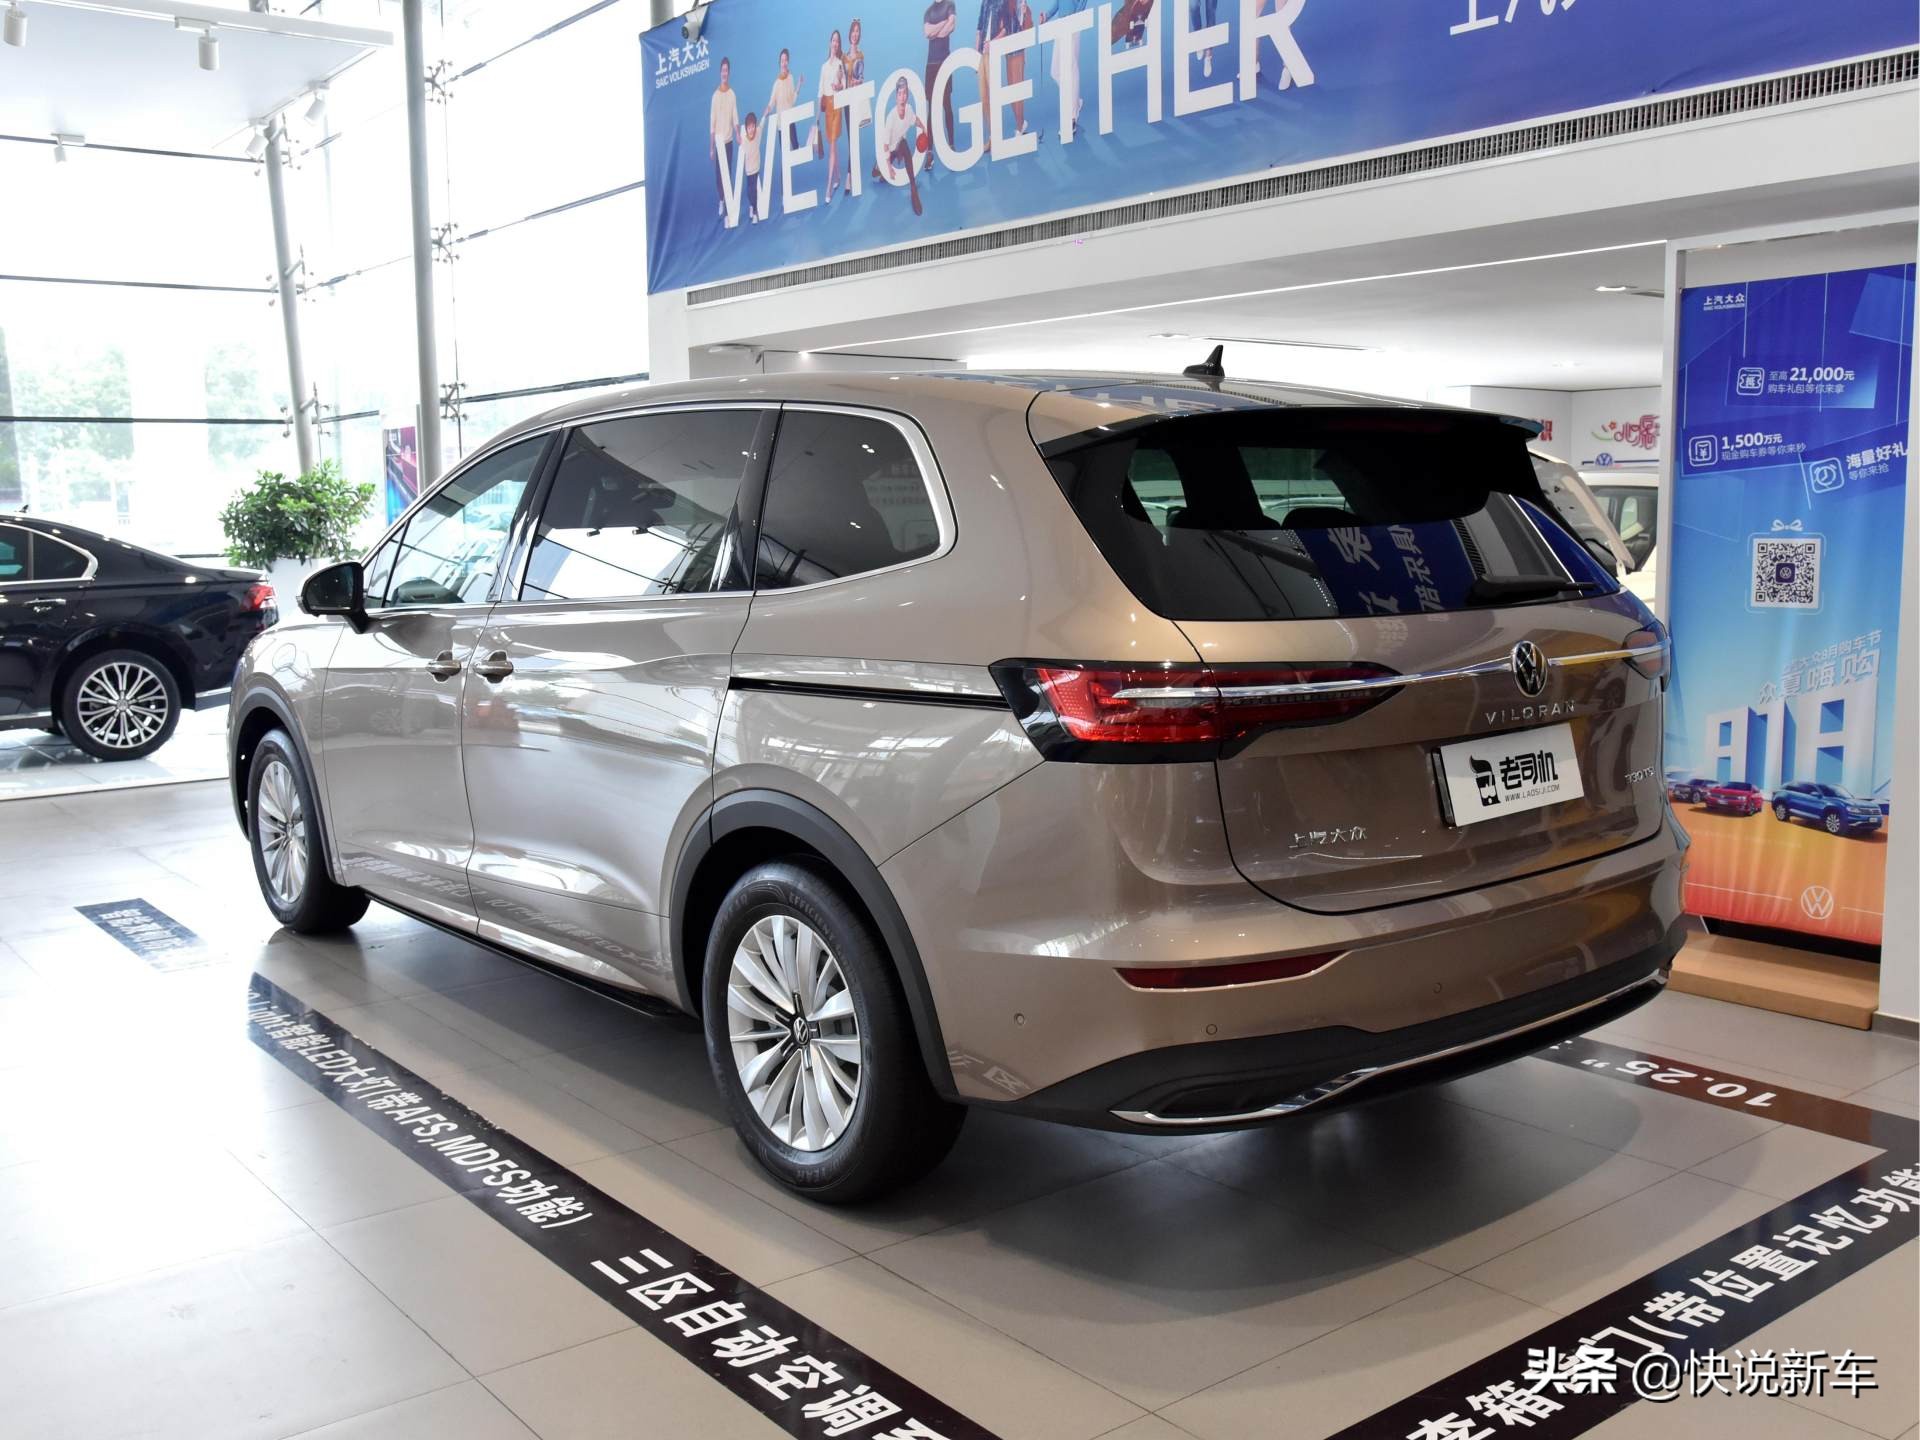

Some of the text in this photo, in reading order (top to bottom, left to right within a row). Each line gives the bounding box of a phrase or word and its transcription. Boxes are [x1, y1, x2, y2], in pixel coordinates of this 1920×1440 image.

[655, 35, 709, 76] 上汽大众
[714, 0, 1316, 228] WE TOGETHER
[1789, 366, 1855, 383] 21,000元
[1721, 432, 1783, 451] 1,500万元
[1846, 441, 1909, 470] 海量好礼
[1485, 700, 1576, 726] VILORAN
[1499, 750, 1559, 790] 老司机
[1504, 784, 1561, 802] WWW.LAOSIJI.COM
